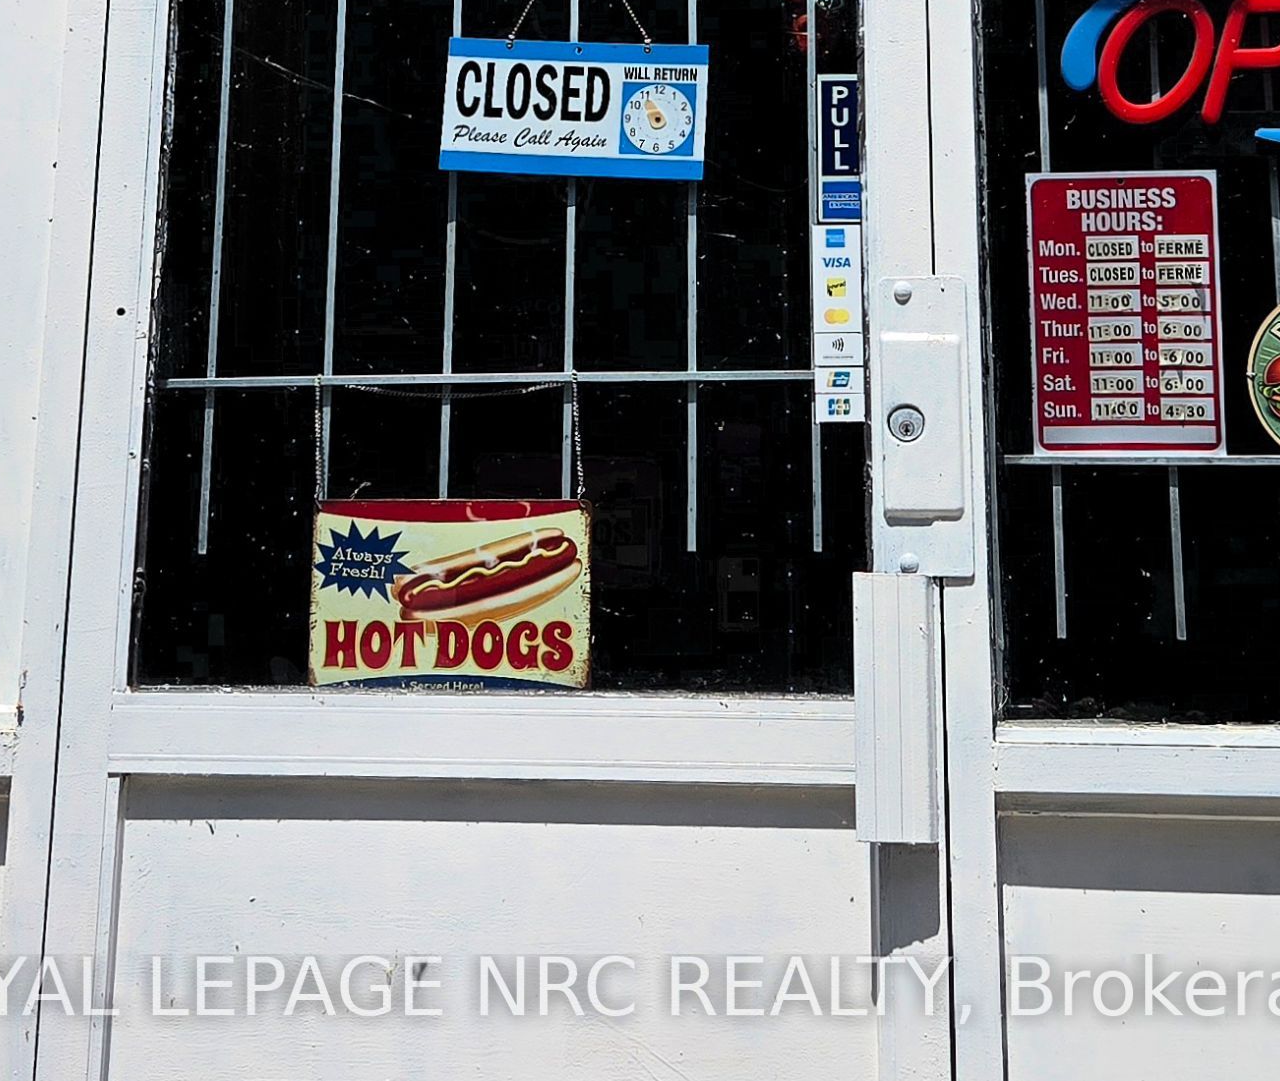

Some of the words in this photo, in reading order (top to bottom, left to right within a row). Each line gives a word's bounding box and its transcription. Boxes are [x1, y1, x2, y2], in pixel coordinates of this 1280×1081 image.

[624, 66, 650, 80] WILL
[654, 67, 698, 82] RETURN
[455, 60, 611, 122] CLOSED
[640, 90, 650, 99] 11
[654, 85, 666, 95] 12
[672, 91, 677, 100] 1
[629, 100, 641, 110] 10
[680, 101, 688, 111] 2
[624, 114, 631, 123] 9
[684, 115, 692, 125] 3
[629, 127, 636, 137] 8
[679, 129, 686, 138] 4
[831, 85, 850, 170] PULL
[453, 124, 507, 144] Please
[514, 127, 552, 148] Call
[554, 129, 608, 151] Again
[639, 138, 646, 148] 7
[667, 140, 675, 150] 5
[652, 142, 660, 152] 6
[822, 192, 859, 201] AMERICAN
[1066, 187, 1176, 209] BUSINESS
[1081, 211, 1163, 232] HOURS:
[1038, 239, 1081, 257] Mon.
[1088, 242, 1133, 256] CLOSED
[1140, 239, 1154, 253] to
[1157, 239, 1203, 255] FERMÉ
[822, 257, 852, 268] VISA
[1038, 266, 1084, 283] Tues.
[1089, 270, 1135, 281] CLOSED
[1141, 266, 1155, 279] to
[1158, 266, 1203, 280] FERMÉ
[1040, 293, 1082, 309] Wed.
[1089, 294, 1131, 309] 11:00
[1143, 294, 1156, 307] to
[1041, 320, 1084, 337] Thur.
[1089, 325, 1132, 338] 11:00
[1144, 321, 1156, 334] to
[1042, 347, 1070, 364] Fri.
[1091, 351, 1132, 364] 11:00
[1145, 348, 1157, 360] to
[1043, 374, 1076, 391] Sat.
[1093, 378, 1134, 391] 11:00
[1146, 375, 1158, 388] to
[1044, 402, 1082, 418] Sun.
[1147, 402, 1159, 415] to
[332, 547, 394, 565] Always
[329, 562, 386, 580] Fresh!
[323, 620, 426, 669] HOT
[434, 620, 574, 671] DOGS
[410, 681, 449, 691] Served
